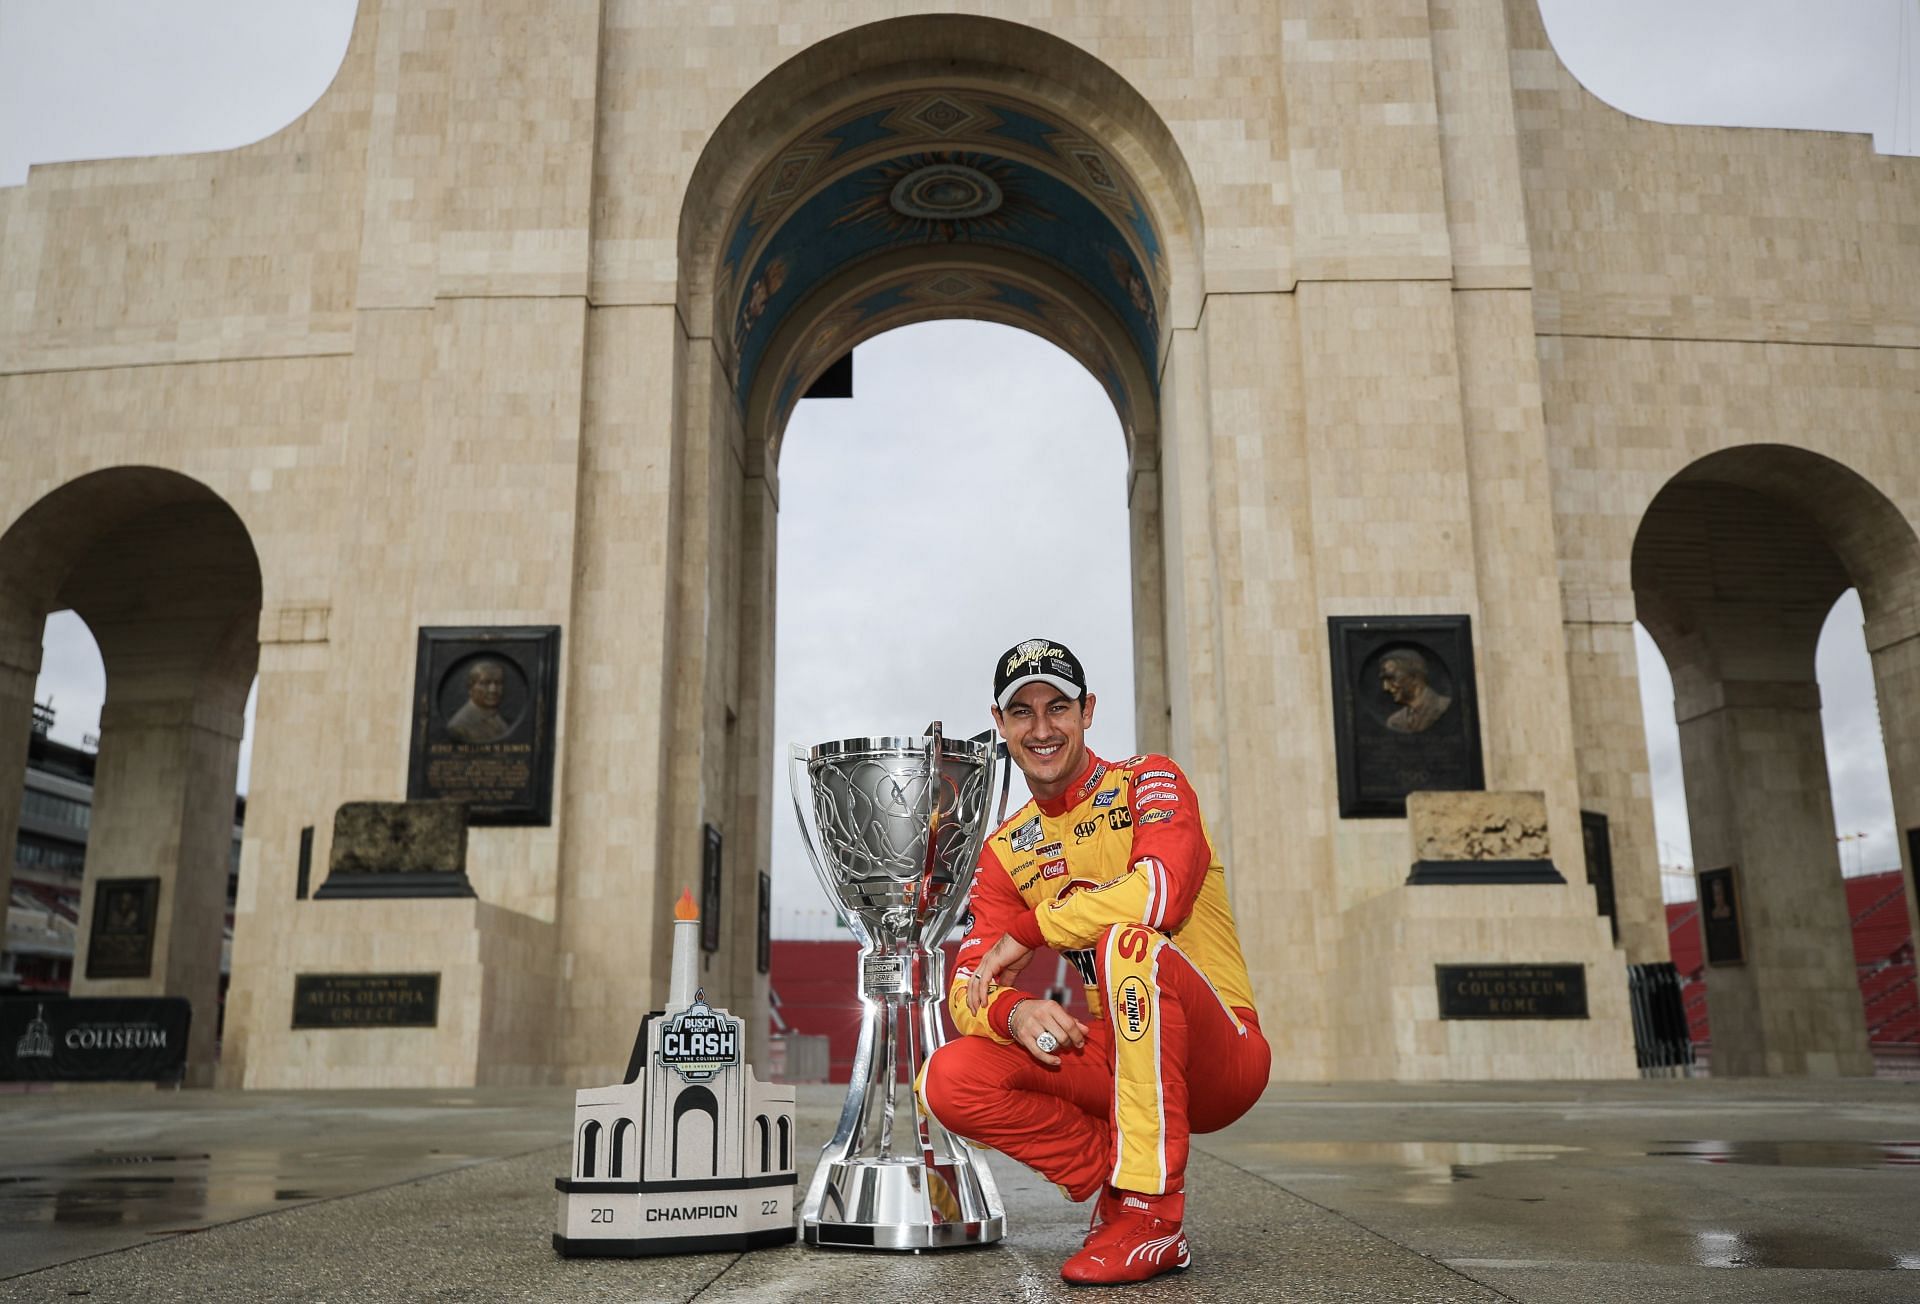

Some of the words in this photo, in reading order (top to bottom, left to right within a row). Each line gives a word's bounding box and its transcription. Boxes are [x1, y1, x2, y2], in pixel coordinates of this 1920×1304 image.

[1086, 763, 1106, 792] PENNZOIL
[1142, 770, 1176, 782] NASCAR
[1109, 809, 1131, 828] PPG
[1139, 809, 1175, 825] SUNOCO
[1075, 822, 1096, 837] AAA
[1019, 872, 1041, 892] ODYEAR
[1457, 981, 1567, 997] COLOSSEUM
[1124, 984, 1141, 1033] PENNZOIL
[684, 1018, 716, 1029] BUSCH
[64, 1028, 167, 1049] COLISEUM
[664, 1033, 735, 1056] CLASH
[591, 1208, 614, 1223] 20
[646, 1205, 738, 1222] CHAMPION
[761, 1200, 778, 1215] 22
[1123, 1197, 1149, 1210] PUMA
